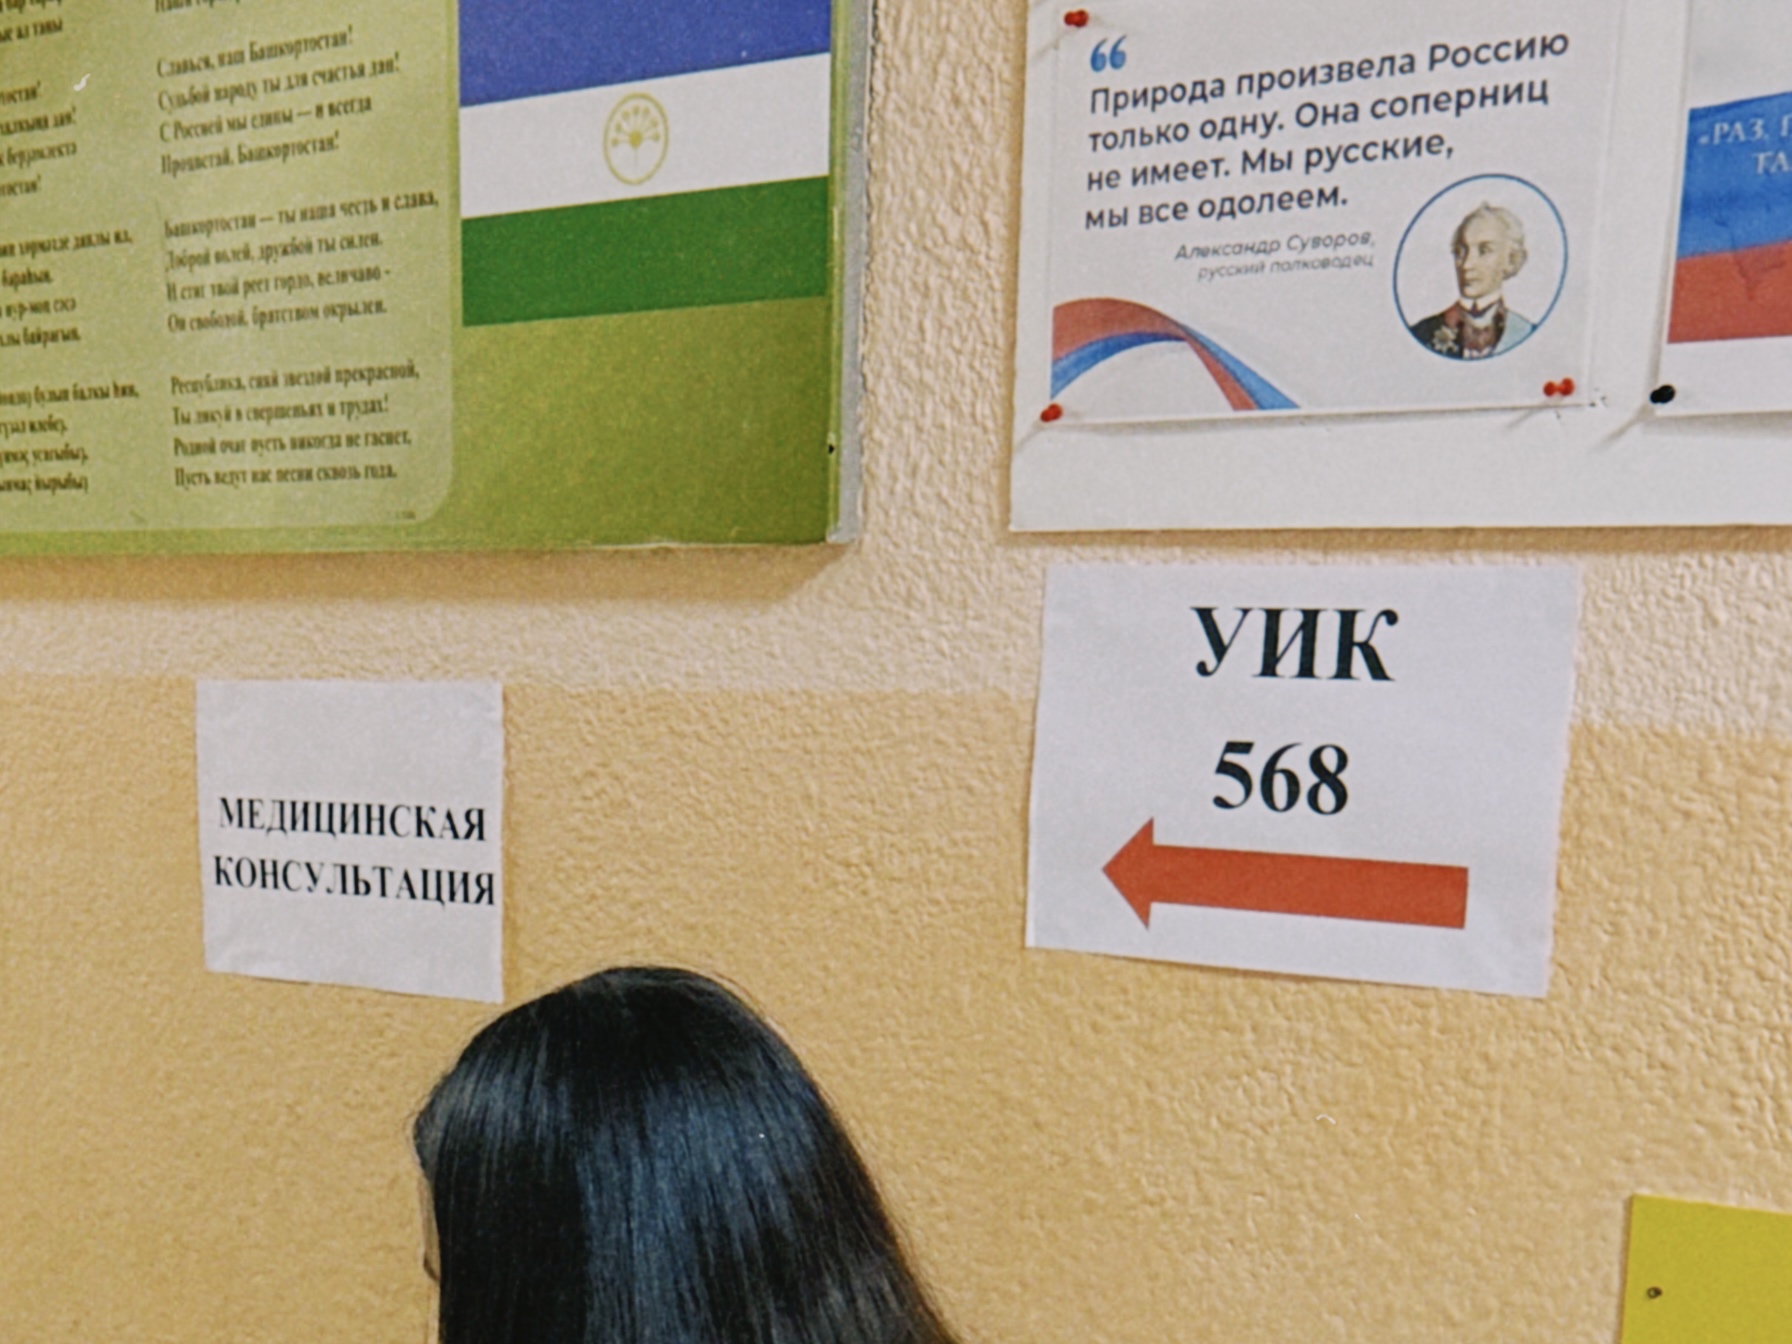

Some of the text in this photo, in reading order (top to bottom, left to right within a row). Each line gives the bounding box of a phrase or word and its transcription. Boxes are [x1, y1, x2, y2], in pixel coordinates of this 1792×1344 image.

[249, 24, 353, 61] Башкортостан!
[1090, 33, 1570, 117] Природа произвела Россию
[1088, 79, 1550, 152] только одну. Она соперниц
[1087, 133, 1454, 192] не имеет. Мы русские,
[1753, 150, 1792, 175] ТА
[1085, 185, 1348, 230] мы все одолеем.
[1174, 231, 1376, 261] Александр Суворов,
[1197, 253, 1374, 283] русский полководец
[1190, 607, 1399, 682] УИК
[1212, 741, 1349, 815] 568
[219, 796, 487, 842] МЕДИЦИНСКАЯ
[212, 855, 496, 909] КОНСУЛЬТАЦИЯ
